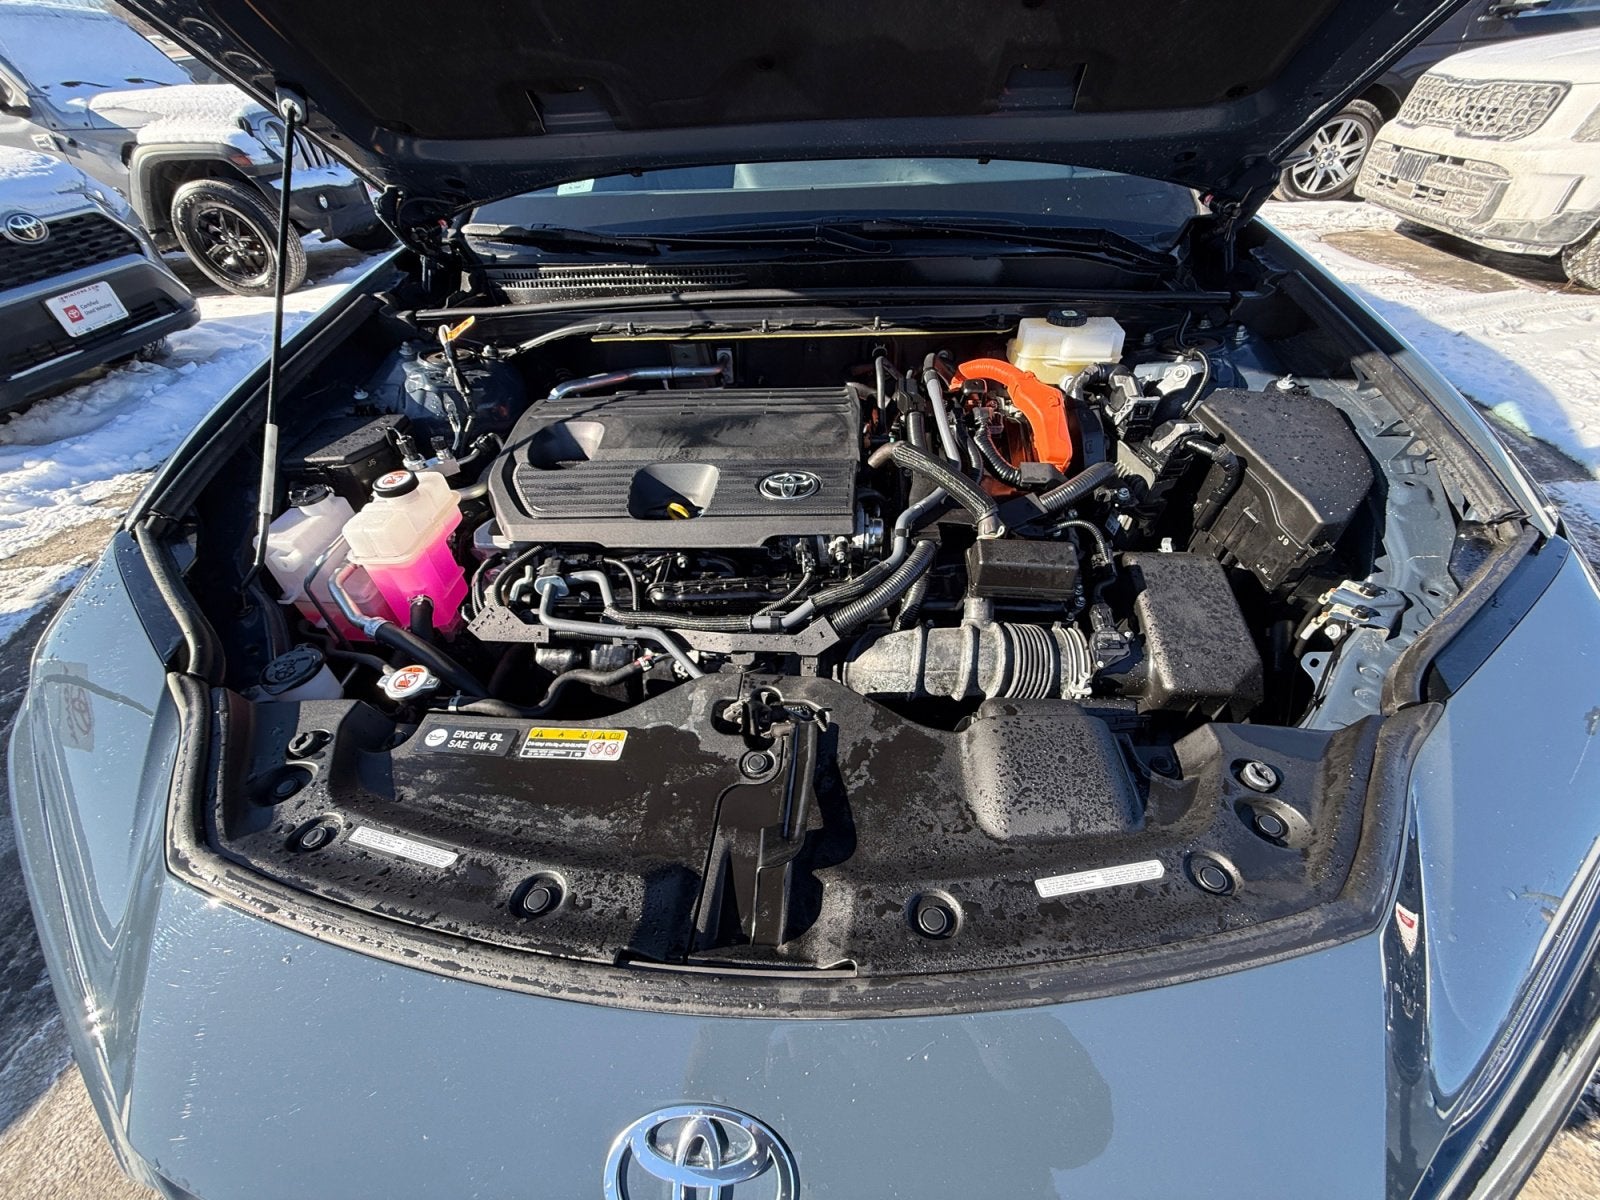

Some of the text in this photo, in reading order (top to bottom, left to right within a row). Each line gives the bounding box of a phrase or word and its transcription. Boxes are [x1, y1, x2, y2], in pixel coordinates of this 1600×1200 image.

[453, 730, 504, 742] ENGINE OIL
[447, 740, 498, 751] SAE 0W-8
